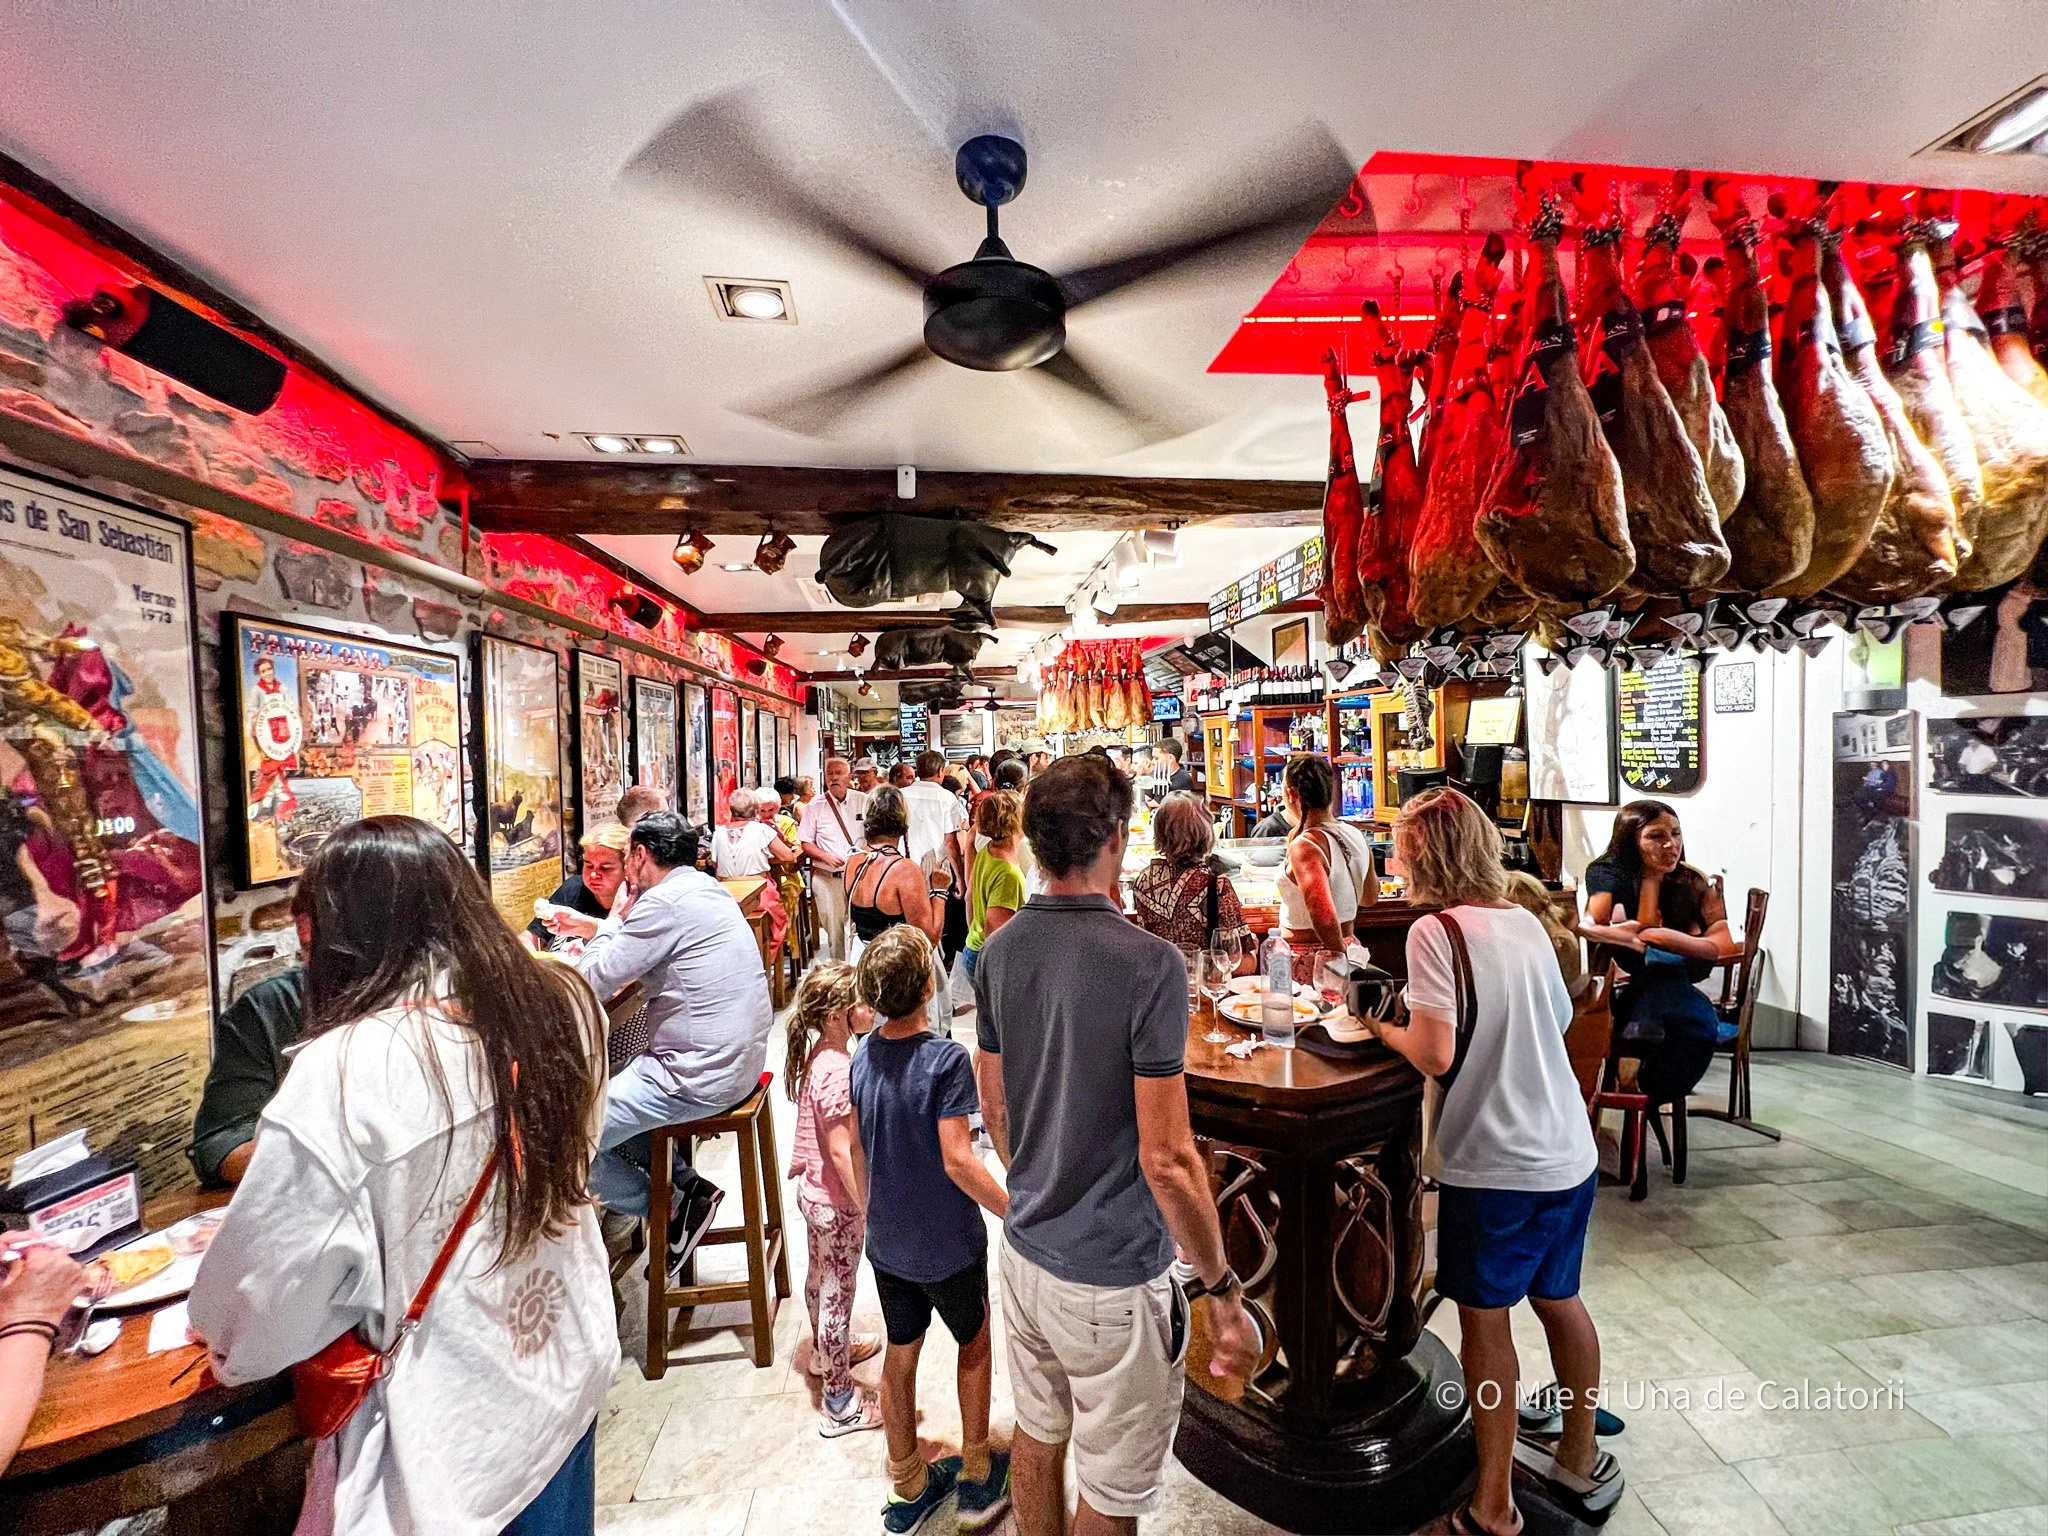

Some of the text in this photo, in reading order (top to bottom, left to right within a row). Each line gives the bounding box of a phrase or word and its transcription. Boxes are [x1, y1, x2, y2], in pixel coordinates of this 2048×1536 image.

[25, 500, 48, 531] de
[57, 508, 91, 543] San
[98, 520, 173, 564] Sebastián
[132, 583, 176, 608] Verano
[141, 607, 172, 624] 1973
[249, 629, 387, 671] PAMPLONA
